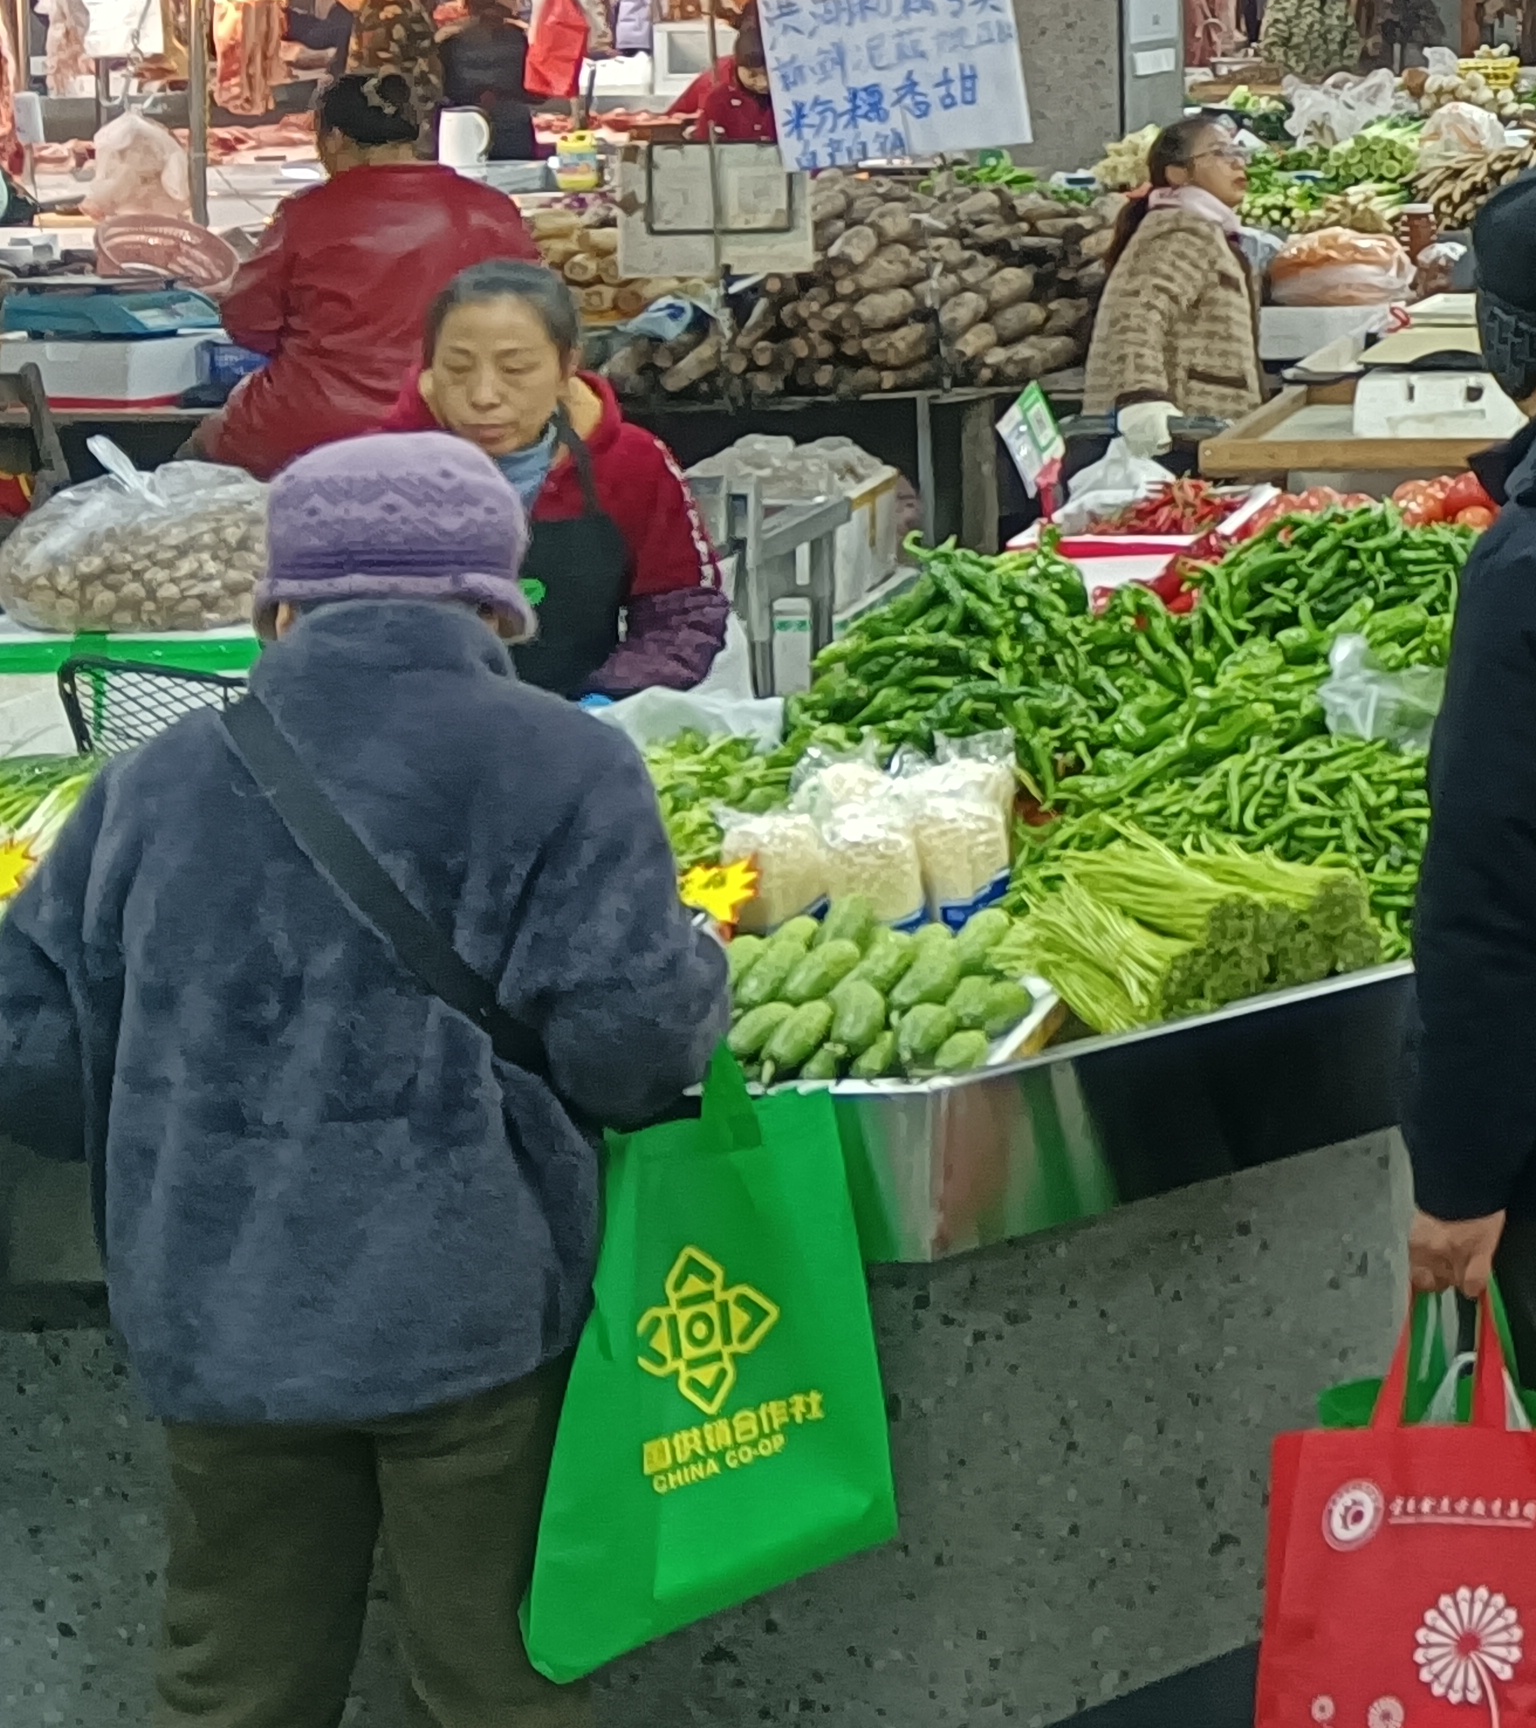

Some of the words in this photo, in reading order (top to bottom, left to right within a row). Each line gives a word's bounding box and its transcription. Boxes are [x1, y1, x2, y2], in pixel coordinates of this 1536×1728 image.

[782, 63, 978, 140] 粉糯香甜
[652, 1457, 722, 1495] CHINA
[724, 1433, 787, 1470] CO-OP
